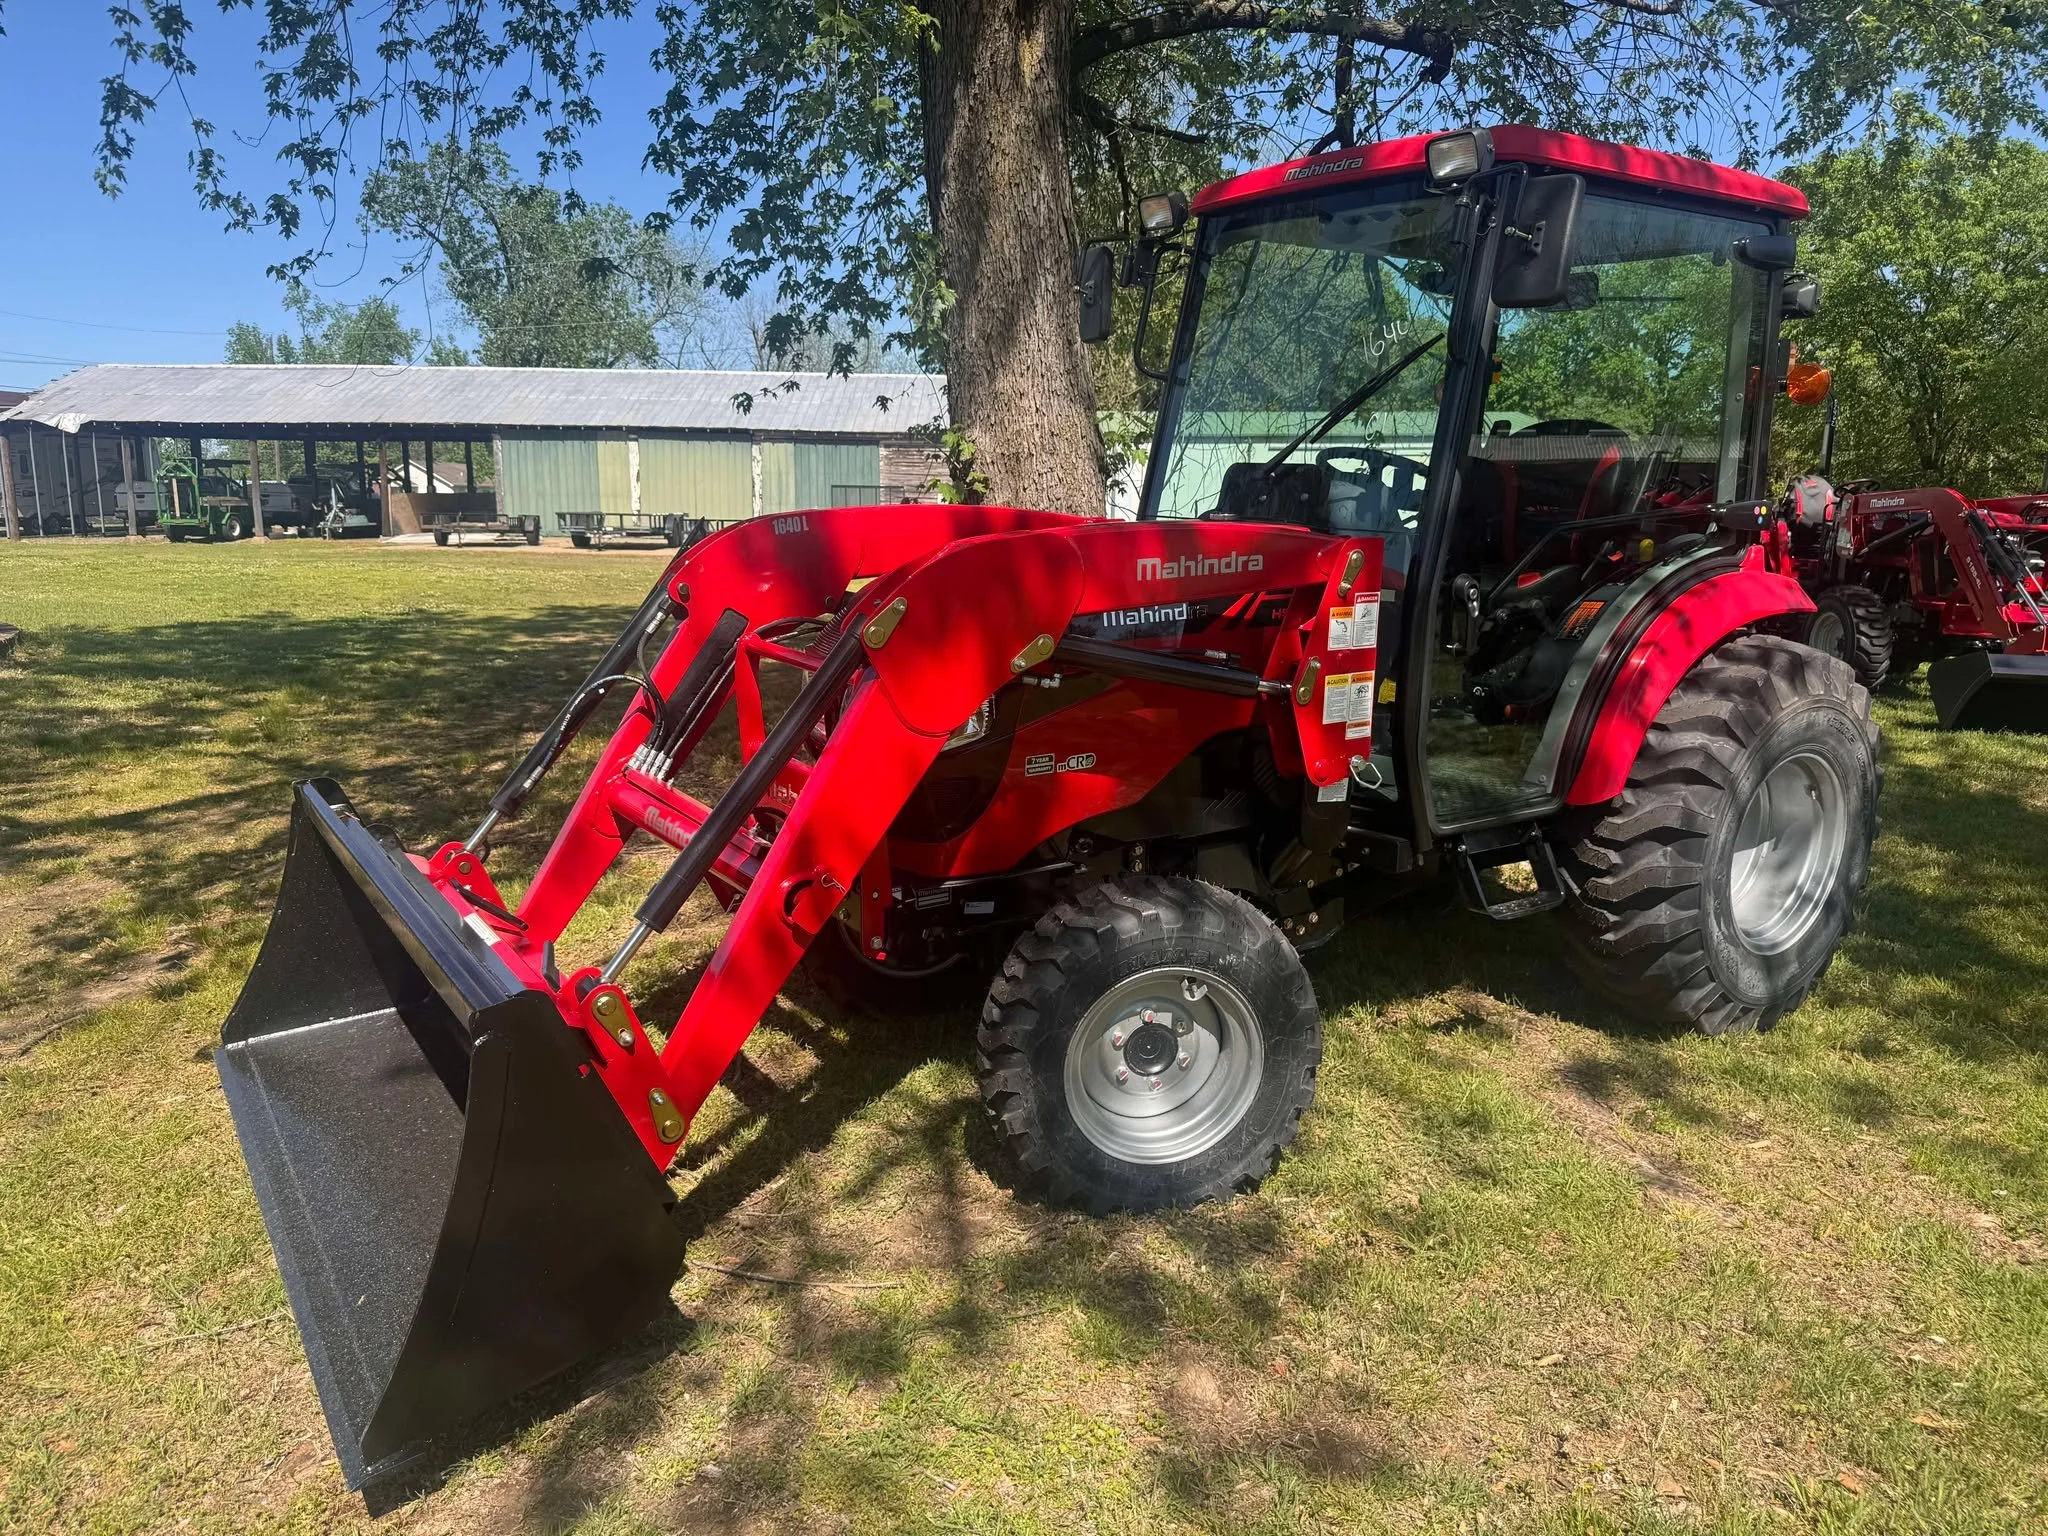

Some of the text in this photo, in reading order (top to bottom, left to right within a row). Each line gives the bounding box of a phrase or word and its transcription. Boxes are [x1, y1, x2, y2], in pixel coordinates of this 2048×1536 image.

[1283, 157, 1364, 182] Mahindra
[1870, 497, 1905, 508] Mahindra
[772, 515, 809, 535] 1640 L
[1136, 551, 1264, 582] Mahindra
